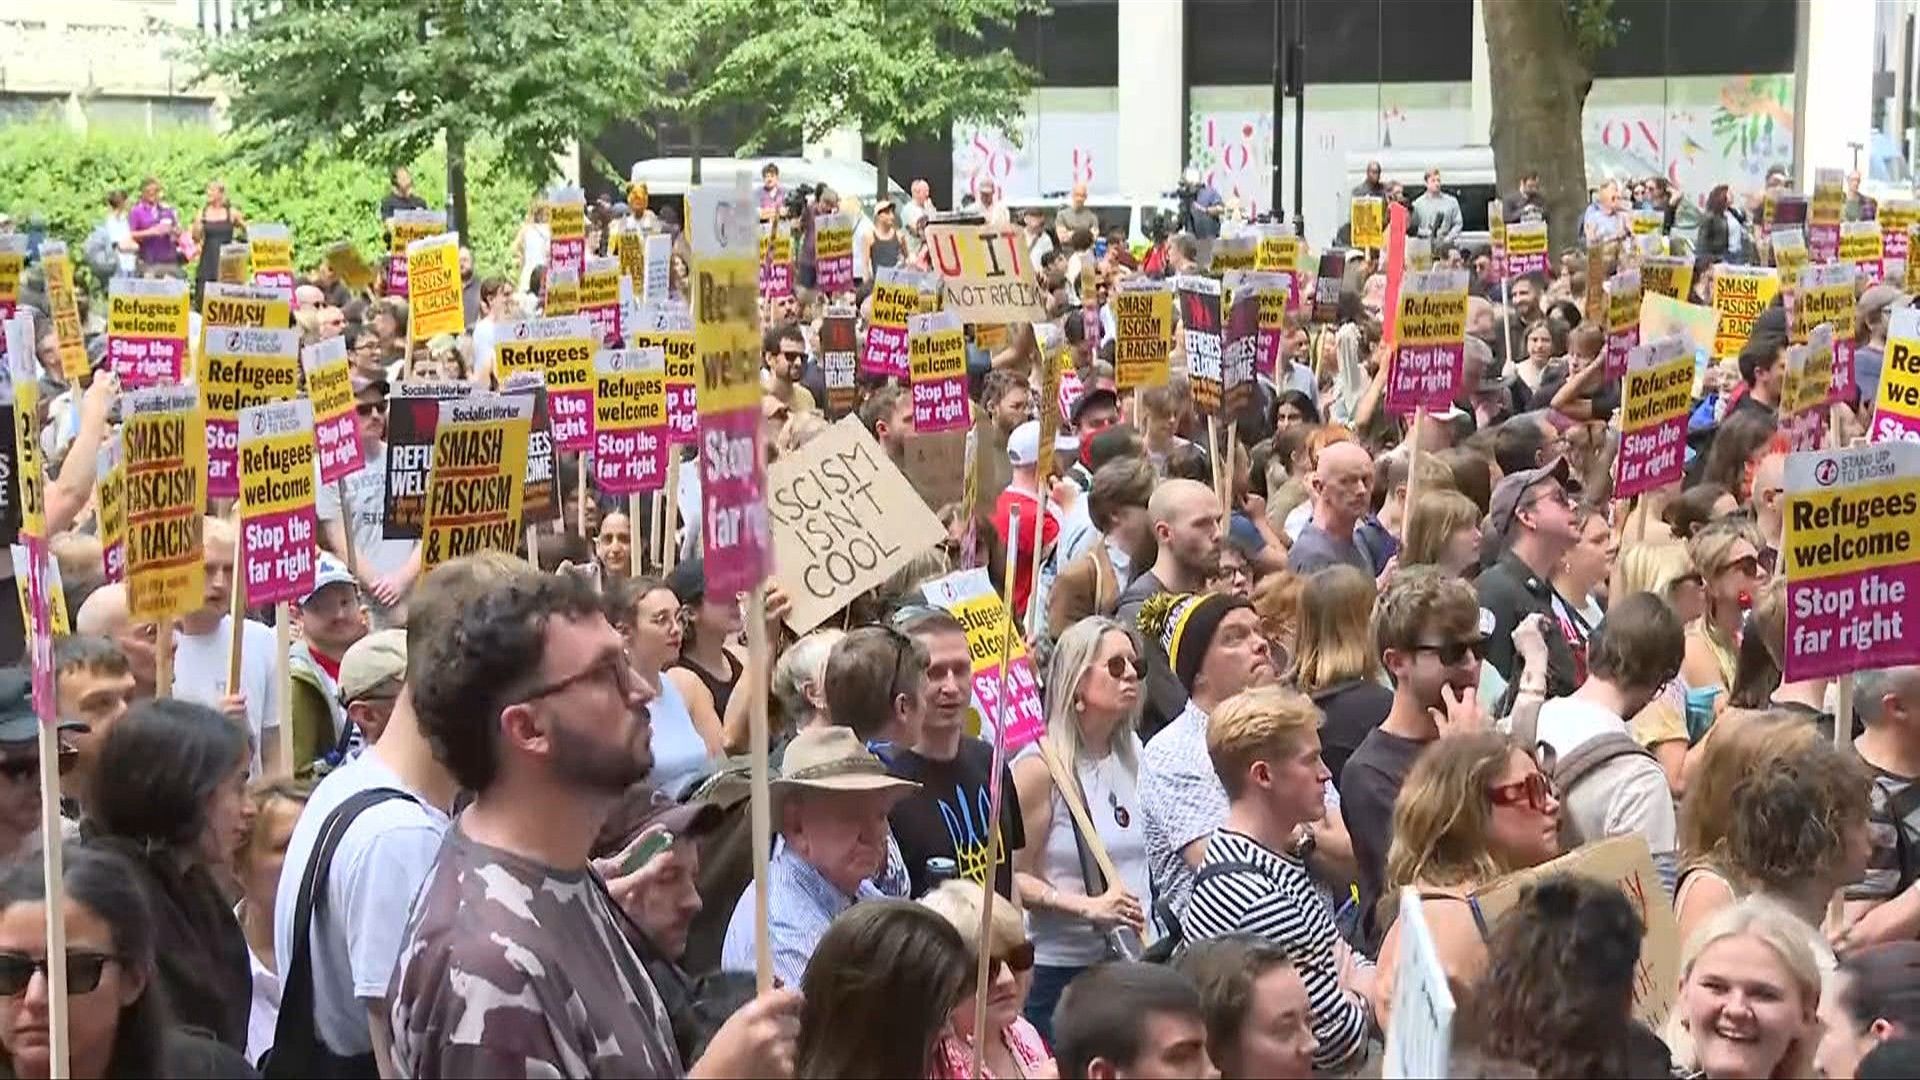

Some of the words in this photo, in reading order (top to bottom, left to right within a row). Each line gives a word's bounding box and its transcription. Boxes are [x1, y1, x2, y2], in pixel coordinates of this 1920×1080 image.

[947, 287, 986, 307] NOT
[1717, 277, 1758, 294] SMASH
[113, 298, 180, 317] Refugees
[1404, 298, 1464, 319] Refugees
[113, 319, 177, 333] welcome
[1403, 320, 1460, 338] welcome
[111, 339, 148, 358] Stop
[149, 339, 174, 356] the
[501, 346, 590, 367] Refugees
[911, 336, 963, 355] Refugees
[913, 355, 962, 375] welcome
[1399, 350, 1432, 372] Stop
[209, 360, 294, 390] Refugees
[598, 376, 662, 400] Refugees
[1631, 366, 1693, 398] Refugees
[914, 384, 942, 402] Stop
[944, 380, 962, 395] the
[452, 406, 492, 423] Socialist
[493, 404, 520, 418] Worker
[555, 396, 587, 414] the
[598, 402, 659, 421] welcome
[1628, 393, 1688, 422] welcome
[126, 420, 184, 463] SMASH
[437, 428, 503, 468] SMASH
[597, 434, 634, 456] Stop
[637, 431, 657, 449] the
[1625, 431, 1656, 457] Stop
[1659, 423, 1680, 445] the
[243, 444, 312, 475] Refugees
[597, 458, 622, 478] far
[626, 457, 657, 480] right
[1621, 460, 1642, 482] far
[1645, 448, 1677, 476] right
[1841, 452, 1873, 470] STAND
[1874, 451, 1890, 464] UP
[1842, 472, 1857, 484] TO
[1858, 463, 1895, 482] RACISM
[127, 466, 197, 513] FASCISM
[244, 476, 311, 507] welcome
[431, 474, 513, 516] FASCISM
[795, 482, 883, 559] ISN'T
[1793, 491, 1917, 531] Refugees
[246, 522, 285, 553] Stop
[287, 515, 311, 543] the
[425, 528, 441, 565] &
[1794, 529, 1911, 568] welcome
[248, 555, 272, 585] far
[275, 546, 312, 582] right
[803, 531, 901, 598] COOL
[1794, 585, 1855, 619] Stop
[1860, 574, 1906, 606] the
[1793, 625, 1832, 656] far
[1839, 610, 1903, 651] right
